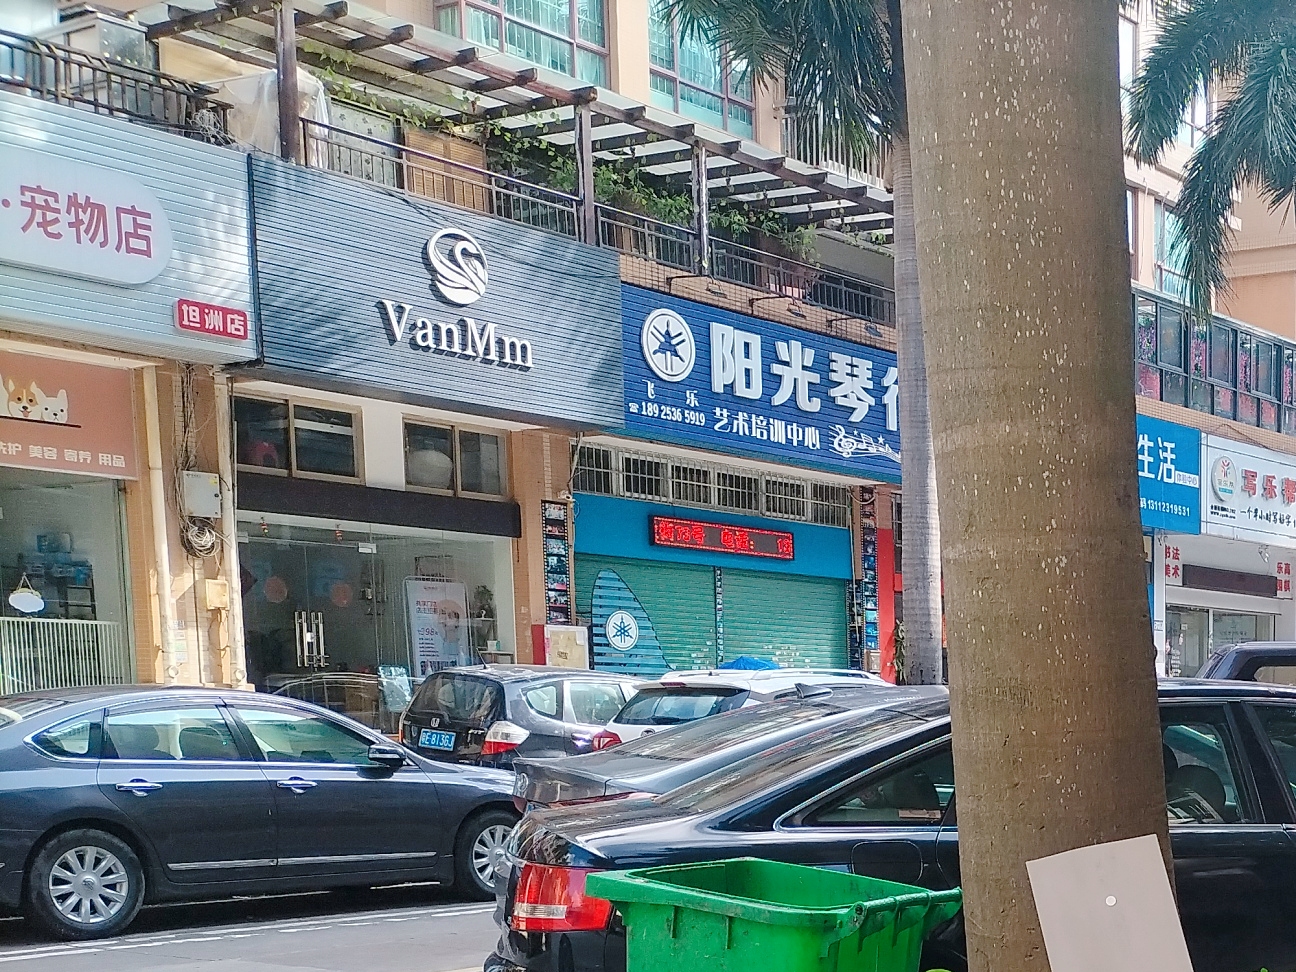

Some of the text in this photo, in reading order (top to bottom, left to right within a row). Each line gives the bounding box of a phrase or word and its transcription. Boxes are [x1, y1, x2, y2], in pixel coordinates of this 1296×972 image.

[181, 303, 245, 336] 坦洲店
[383, 300, 534, 368] VanMm
[641, 401, 706, 427] 189 2536 5919
[712, 407, 821, 450] 艺术培训中心
[28, 445, 58, 460] 美容
[63, 449, 92, 464] 寄养
[98, 453, 126, 468] 用品
[1276, 562, 1291, 576] 乐高
